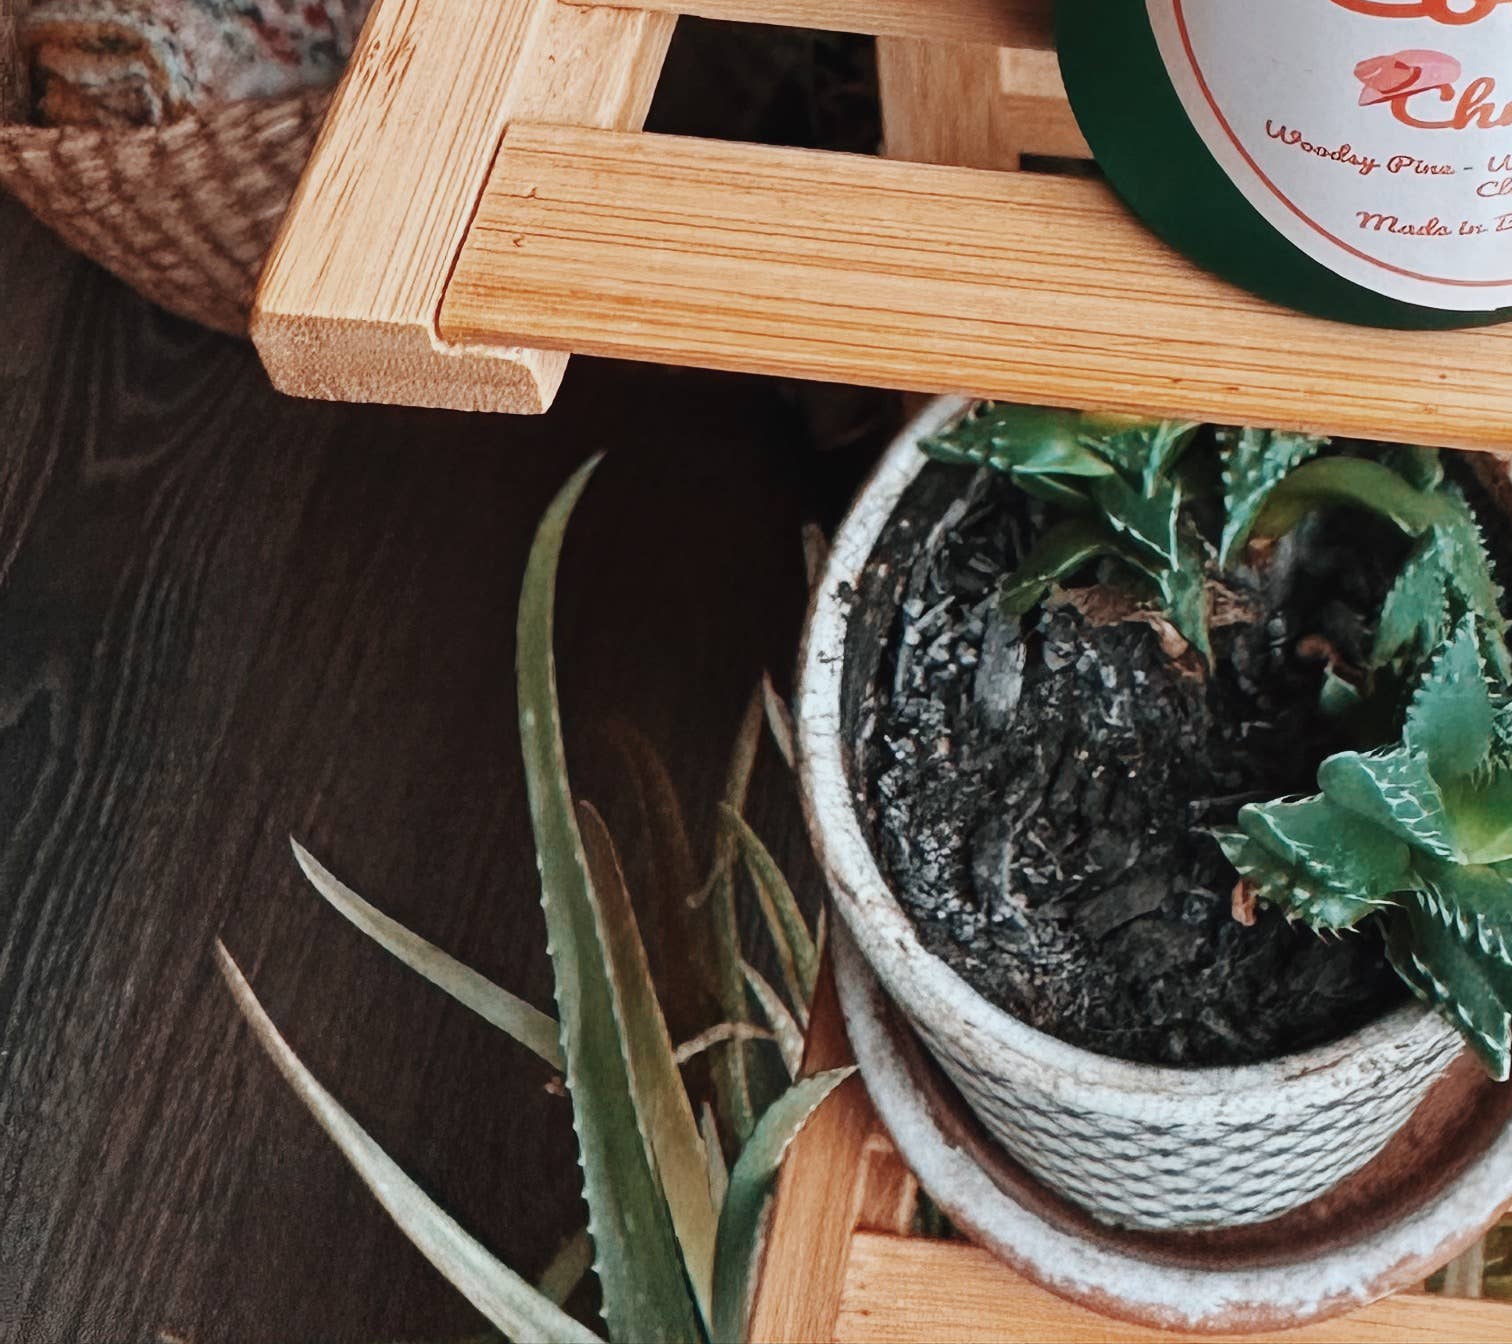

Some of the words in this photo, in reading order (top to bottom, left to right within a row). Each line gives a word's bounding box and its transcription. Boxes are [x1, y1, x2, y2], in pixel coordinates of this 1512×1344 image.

[1265, 119, 1381, 176] Woodsy
[1386, 155, 1456, 175] Pine
[1356, 211, 1453, 236] Made
[1458, 220, 1489, 236] in
